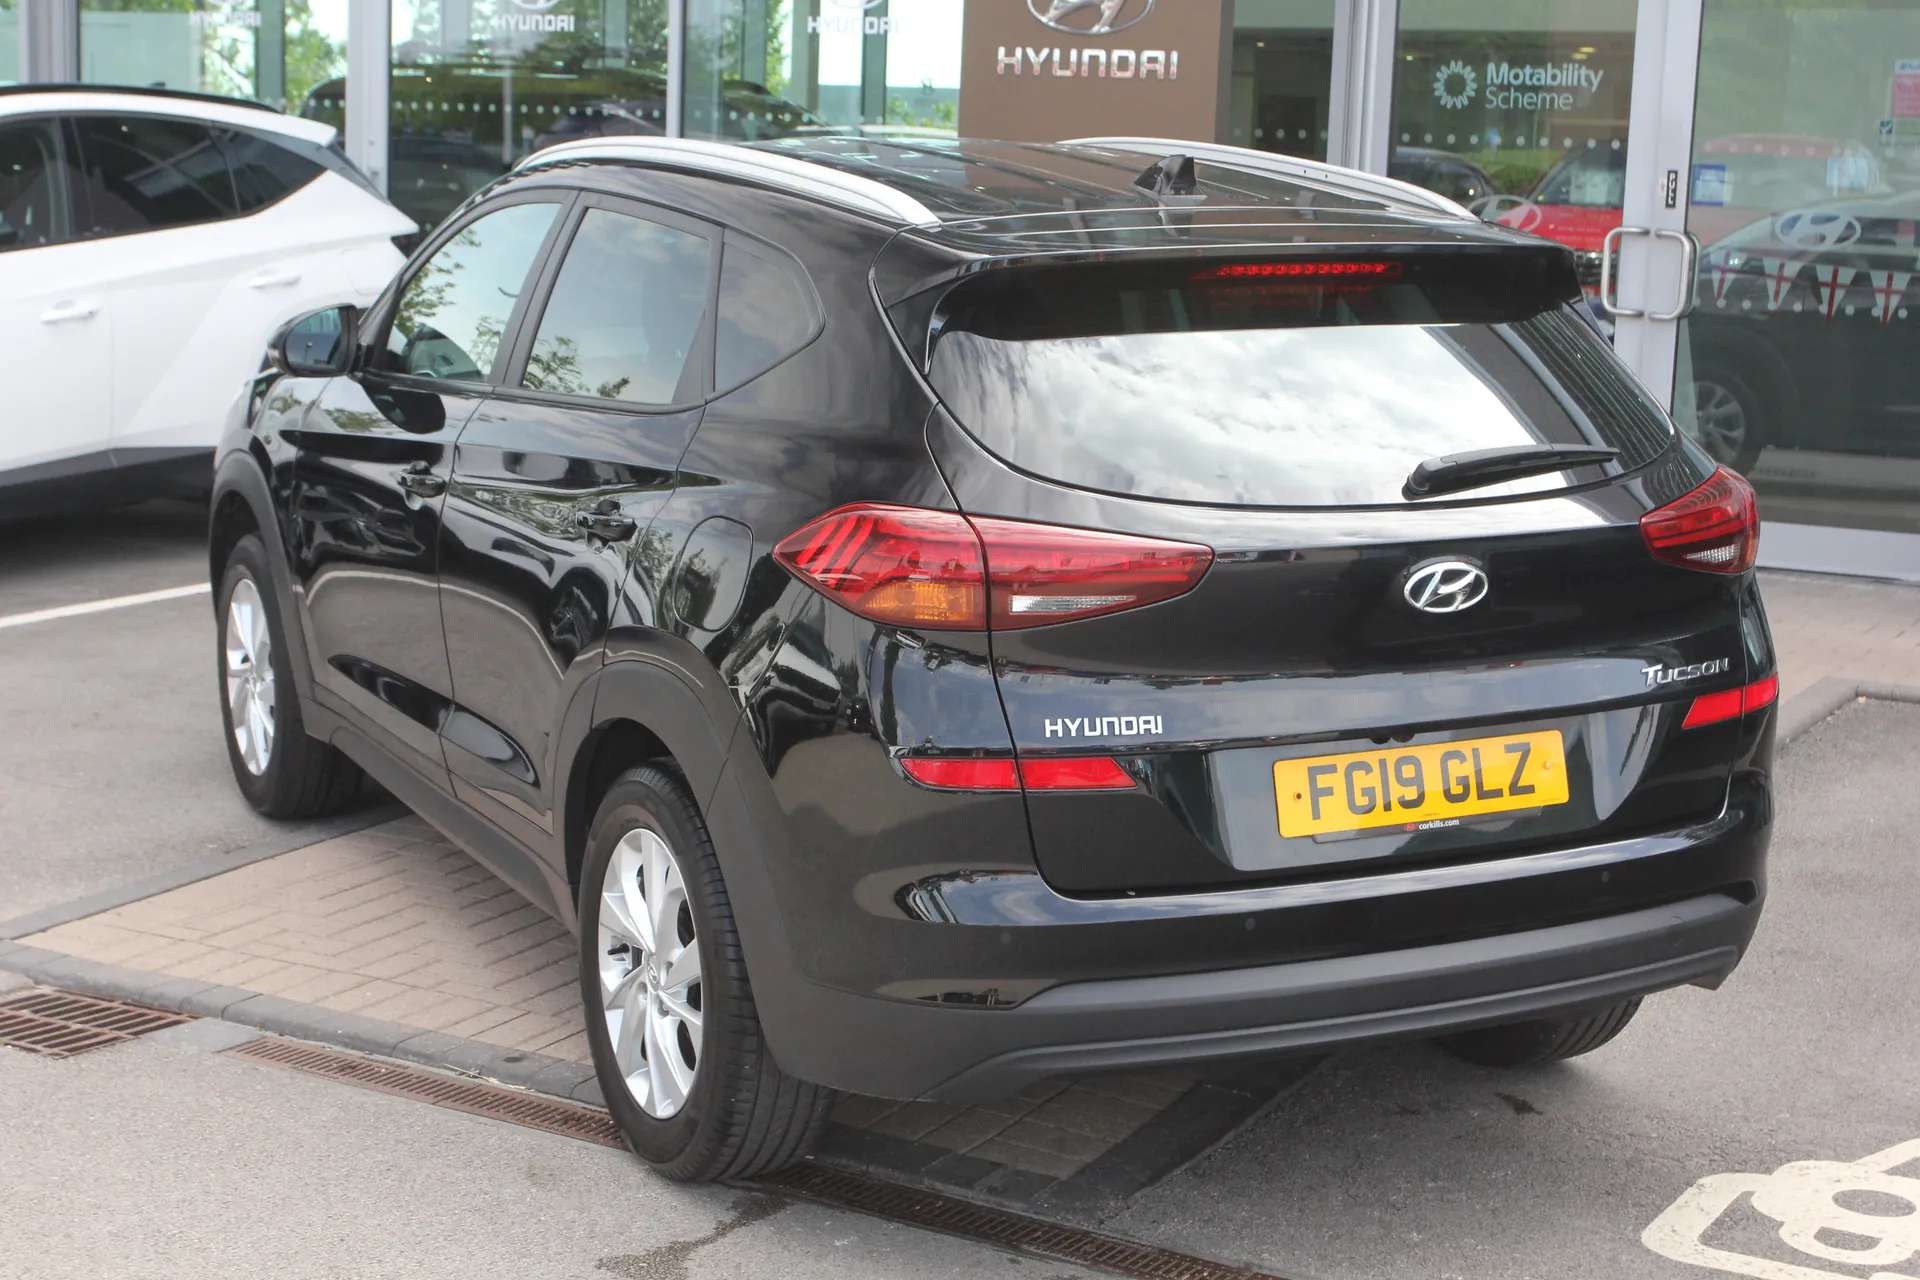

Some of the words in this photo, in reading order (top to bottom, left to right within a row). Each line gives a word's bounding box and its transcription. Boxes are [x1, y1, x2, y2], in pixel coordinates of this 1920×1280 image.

[497, 15, 575, 31] HYUNDAI
[997, 46, 1179, 79] HYUNDAI
[1486, 62, 1604, 92] Motability
[1486, 87, 1574, 110] Scheme
[1044, 715, 1163, 738] HYUNDAI
[1307, 755, 1425, 820] FG19
[1440, 742, 1536, 803] GLZ
[1418, 819, 1460, 830] corkills.com
